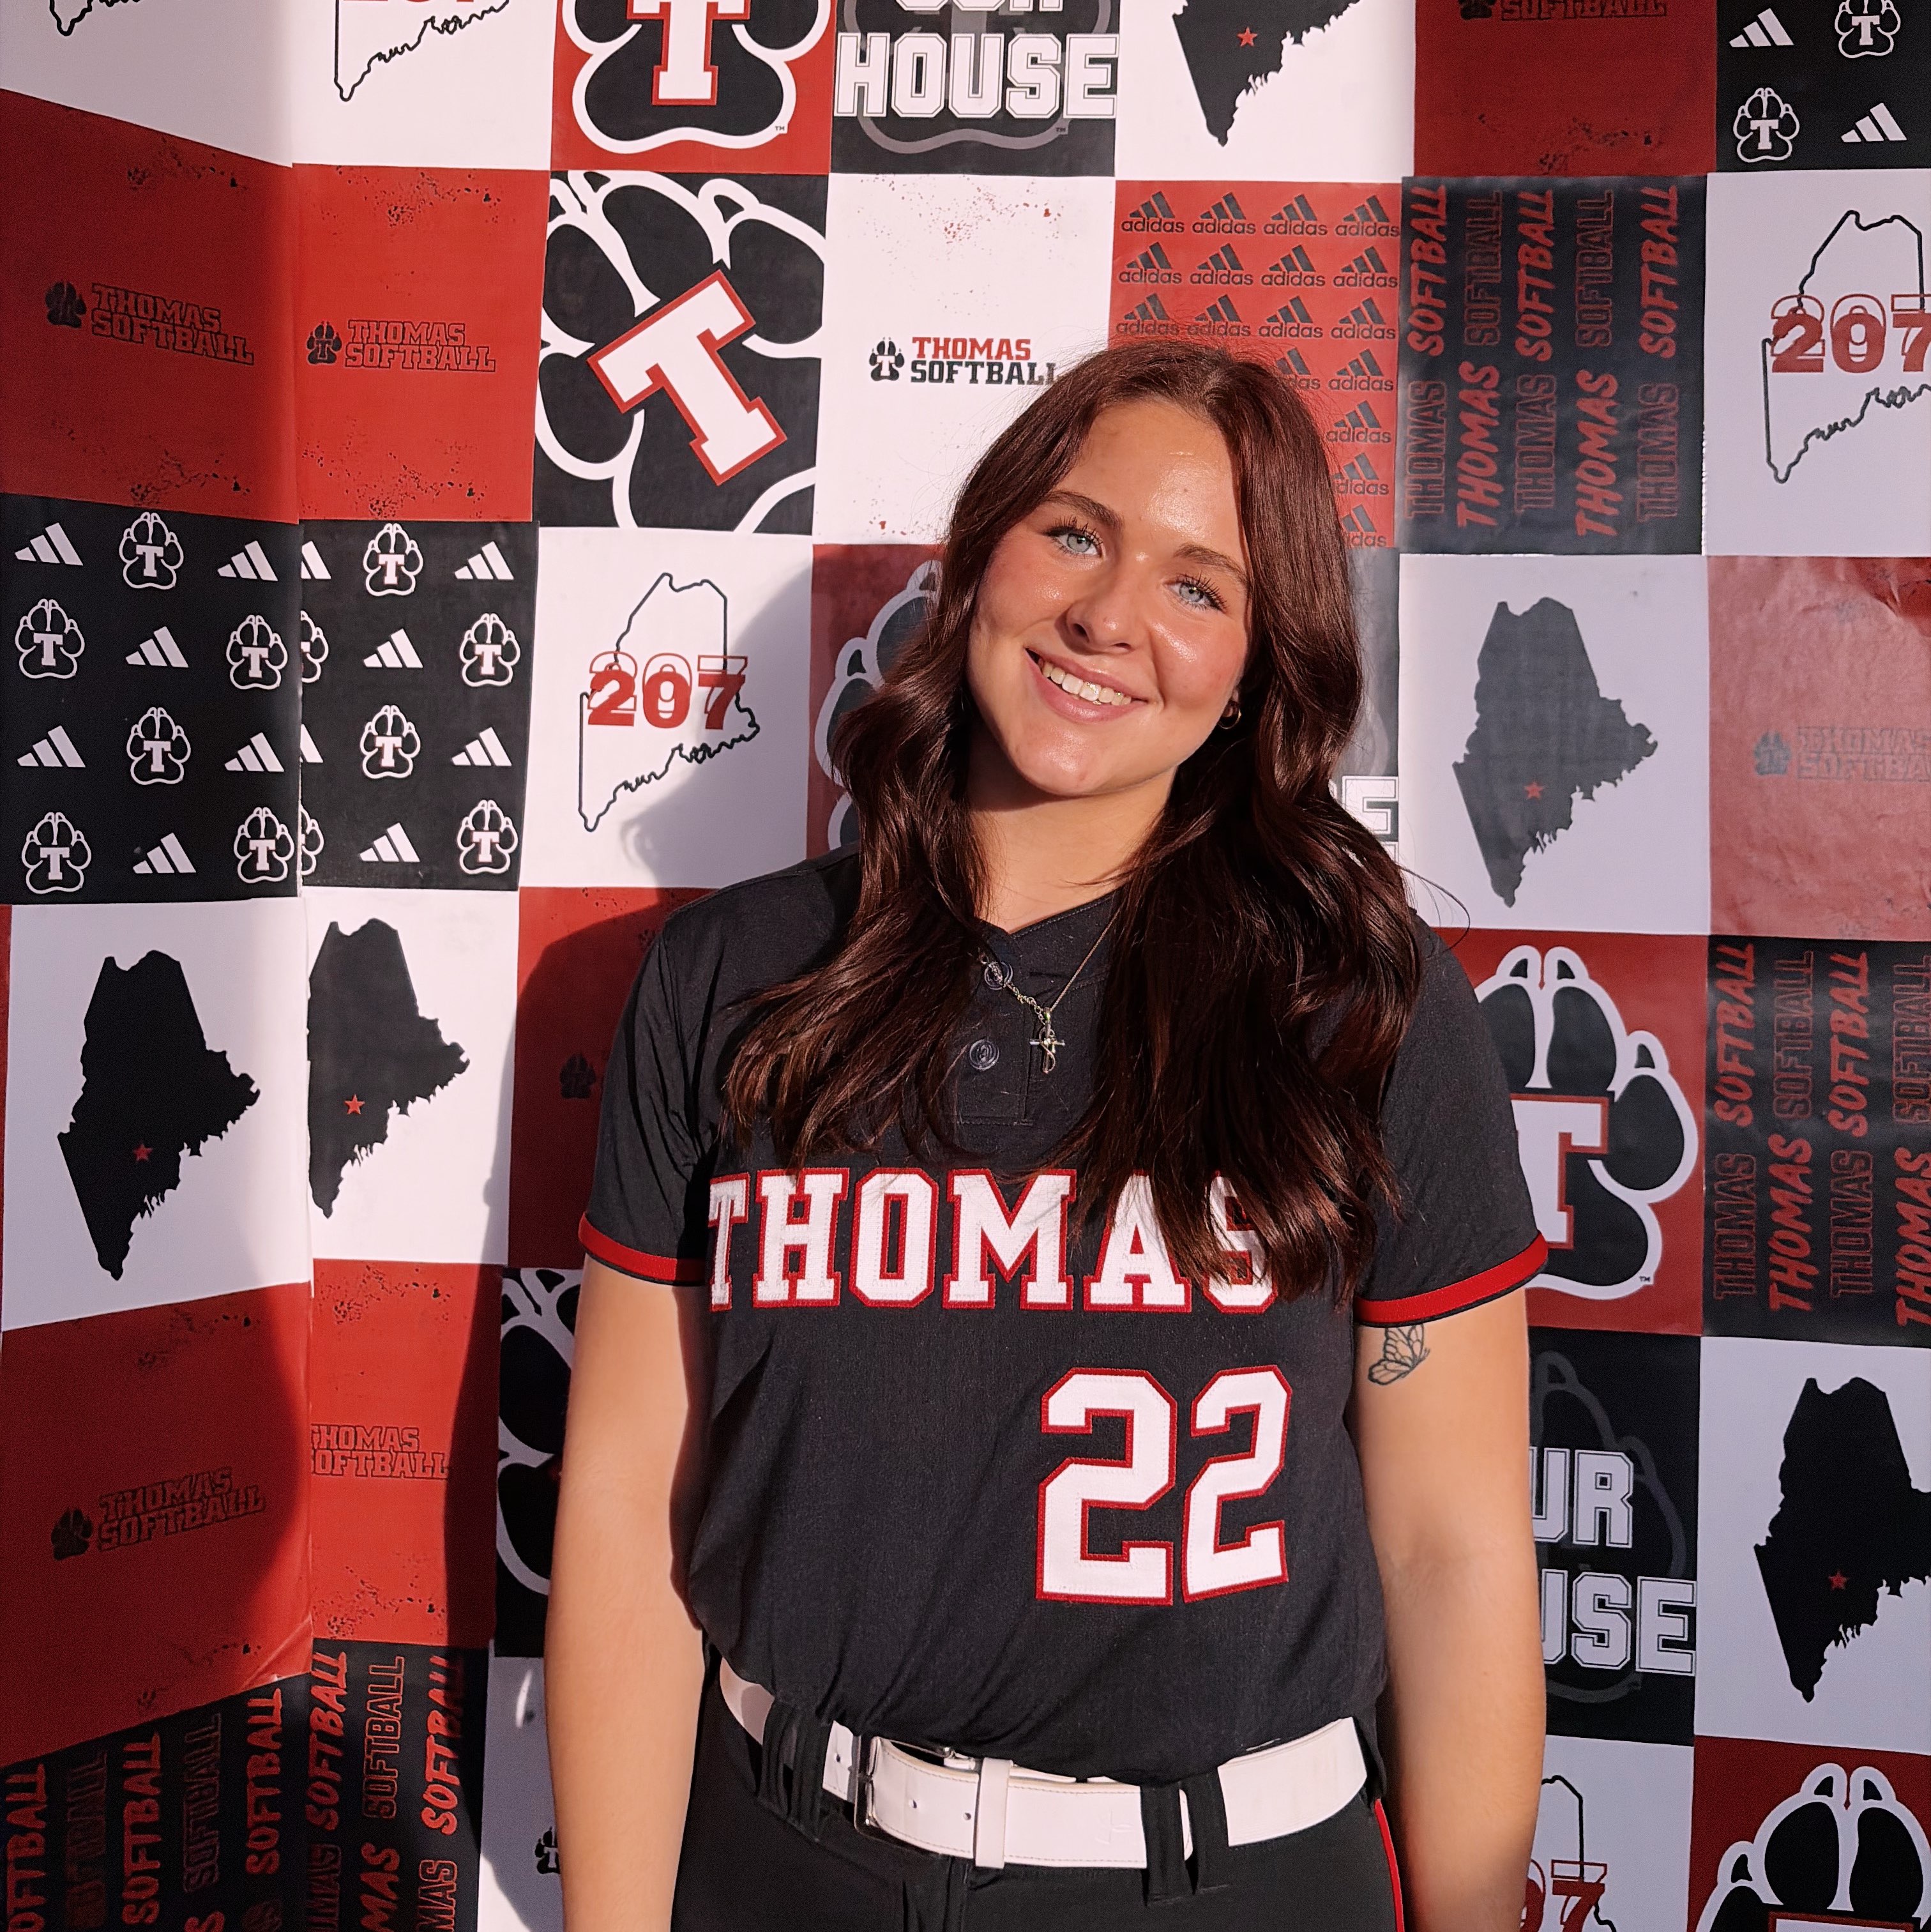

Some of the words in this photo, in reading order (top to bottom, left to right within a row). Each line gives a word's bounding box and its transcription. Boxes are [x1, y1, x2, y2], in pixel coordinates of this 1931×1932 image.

[1851, 15, 1880, 45] T
[834, 33, 1119, 119] HOUSE
[1750, 119, 1778, 149] T
[1121, 218, 1185, 234] adidas
[1192, 218, 1256, 235] adidas
[1263, 220, 1328, 236] adidas
[1335, 221, 1400, 238] adidas
[92, 282, 221, 333] THOMAS
[1119, 268, 1182, 284] adidas
[1190, 270, 1253, 285] adidas
[1261, 271, 1326, 287] adidas
[1333, 272, 1398, 288] adidas
[1407, 184, 1446, 356] SOFTBALL
[1515, 188, 1554, 362] SOFTBALL
[1639, 185, 1678, 358] SOFTBALL
[91, 308, 254, 365] SOFTBALL
[345, 342, 496, 372] SOFTBALL
[348, 319, 466, 346] THOMAS
[912, 337, 1031, 360] THOMAS
[1116, 320, 1180, 336] adidas
[1186, 321, 1250, 337] adidas
[1258, 323, 1323, 338] adidas
[1330, 323, 1396, 340] adidas
[1770, 294, 1931, 373] 207
[587, 270, 787, 485] T
[1328, 376, 1394, 392] adidas
[1326, 428, 1391, 443] adidas
[1405, 380, 1446, 519] THOMAS
[1457, 361, 1504, 529] THOMAS
[1515, 374, 1556, 515] THOMAS
[1576, 370, 1621, 537] THOMAS
[1637, 383, 1677, 522] THOMAS
[1335, 481, 1390, 496] didas
[136, 545, 163, 576] T
[378, 553, 405, 585] T
[33, 633, 63, 666] T
[241, 646, 268, 678] T
[474, 644, 502, 676] T
[587, 651, 748, 730] 207
[144, 741, 171, 773] T
[375, 736, 402, 767] T
[40, 847, 70, 880] T
[249, 840, 275, 871] T
[473, 831, 499, 862] T
[1713, 943, 1755, 1127] SOFTBALL
[1773, 950, 1815, 1120] SOFTBALL
[1828, 951, 1869, 1137] SOFTBALL
[709, 1167, 1278, 1314] THOMAS
[1713, 1152, 1757, 1300] THOMAS
[1769, 1132, 1819, 1312] THOMAS
[1829, 1150, 1874, 1298] THOMAS
[98, 1466, 232, 1523] THOMAS
[311, 1449, 450, 1480] OFTBALL
[1036, 1364, 1292, 1606] 22
[1529, 1447, 1633, 1548] UR
[97, 1484, 266, 1552] SOFTBALL
[306, 1651, 347, 1831] SOFTBALL
[362, 1655, 405, 1819] SOFTBALL
[421, 1655, 465, 1835] SOFTBALL
[245, 1688, 282, 1875] SOFTBALL
[5, 1763, 47, 1932] OFTBALL
[121, 1731, 162, 1925] SOFTBALL
[359, 1843, 400, 1932] MAS
[417, 1859, 457, 1932] MAS
